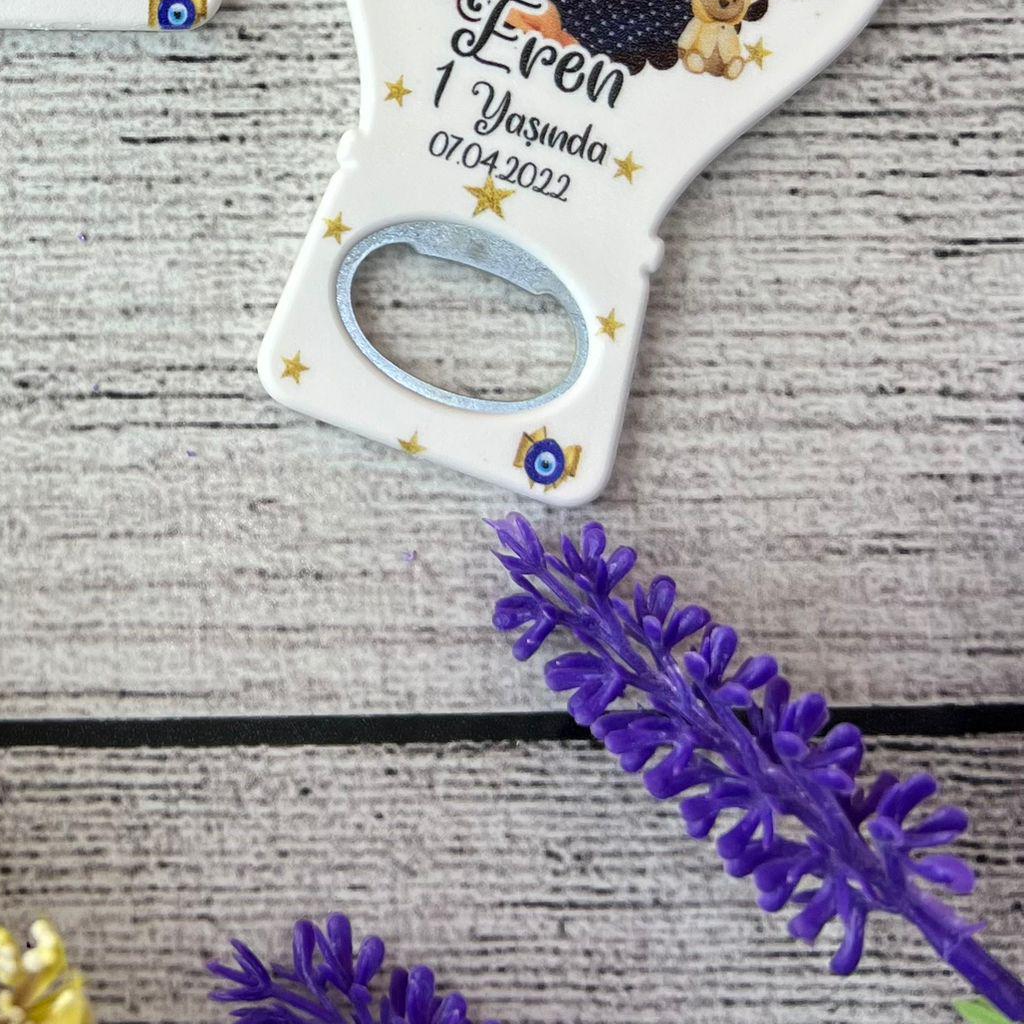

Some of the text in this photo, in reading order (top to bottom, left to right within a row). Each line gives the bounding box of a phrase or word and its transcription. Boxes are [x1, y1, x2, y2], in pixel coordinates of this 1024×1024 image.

[433, 59, 608, 165] 1 Yaşında
[428, 130, 572, 202] 07.04.2022
